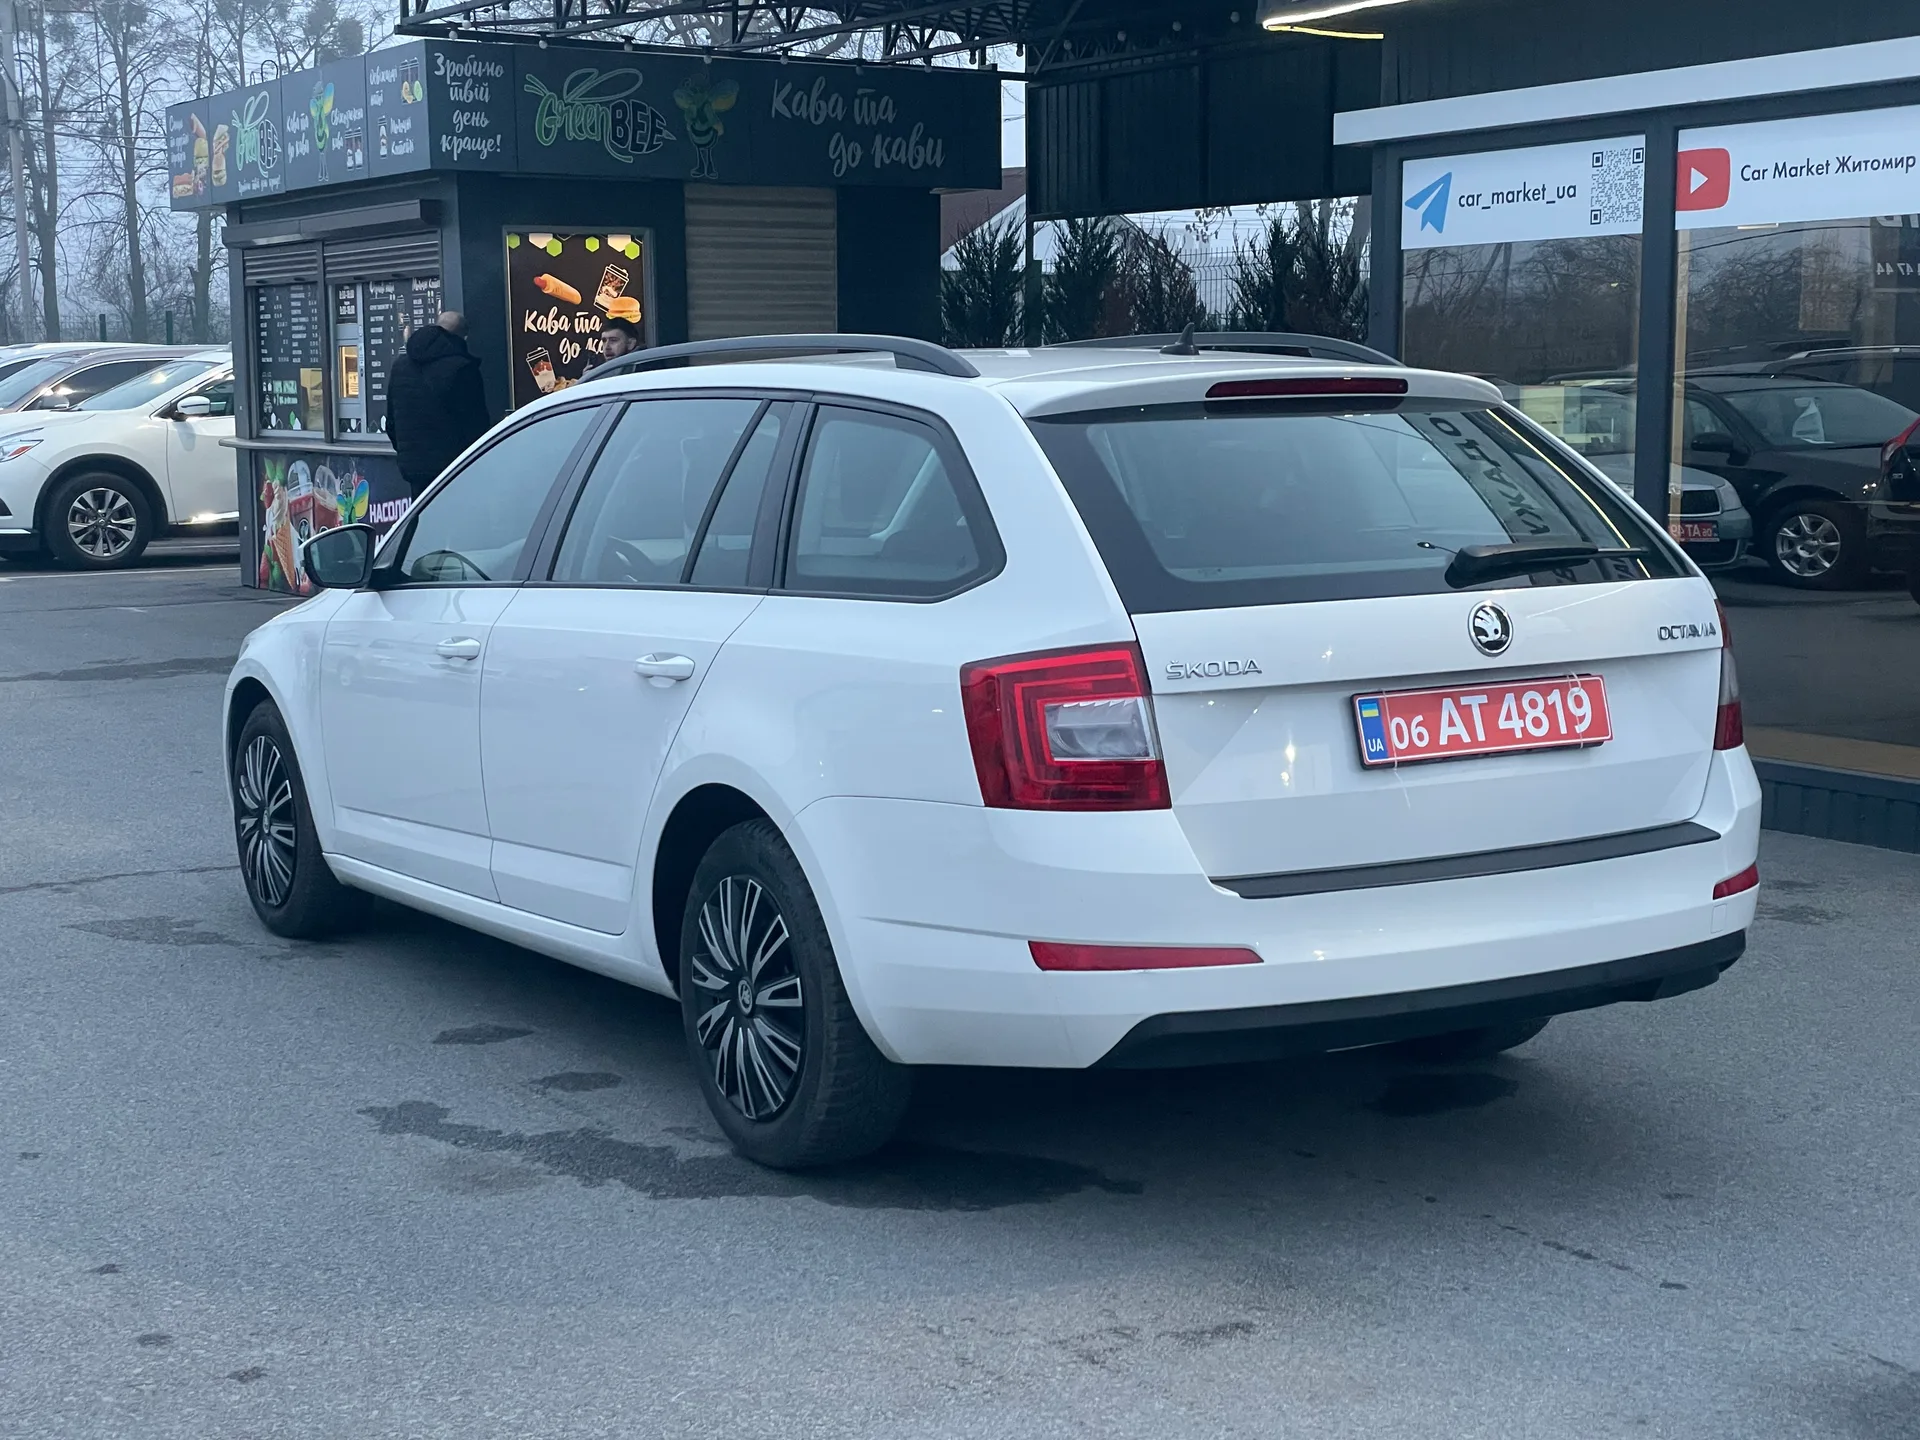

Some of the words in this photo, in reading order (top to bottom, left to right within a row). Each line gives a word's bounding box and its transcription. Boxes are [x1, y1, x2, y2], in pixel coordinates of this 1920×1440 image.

[434, 52, 504, 85] Зробимо
[449, 78, 491, 103] твій
[771, 75, 848, 126] Кава
[853, 88, 898, 126] та
[452, 109, 491, 133] день
[440, 134, 502, 161] краще!
[828, 131, 863, 178] до
[871, 121, 946, 170] кави
[1740, 164, 1768, 182] Car
[1772, 158, 1831, 180] Market
[1834, 155, 1917, 174] Житомир
[1458, 181, 1577, 210] car_market_ua
[524, 305, 571, 336] Кава
[574, 311, 602, 334] та
[558, 337, 582, 365] до
[369, 497, 413, 523] НАСОЛО
[1656, 622, 1717, 641] OCTAVIA
[1165, 659, 1263, 680] ŠKODA
[1389, 714, 1430, 750] 06
[1439, 694, 1488, 746] AT
[1498, 687, 1593, 739] 4819
[1368, 738, 1385, 753] UA
